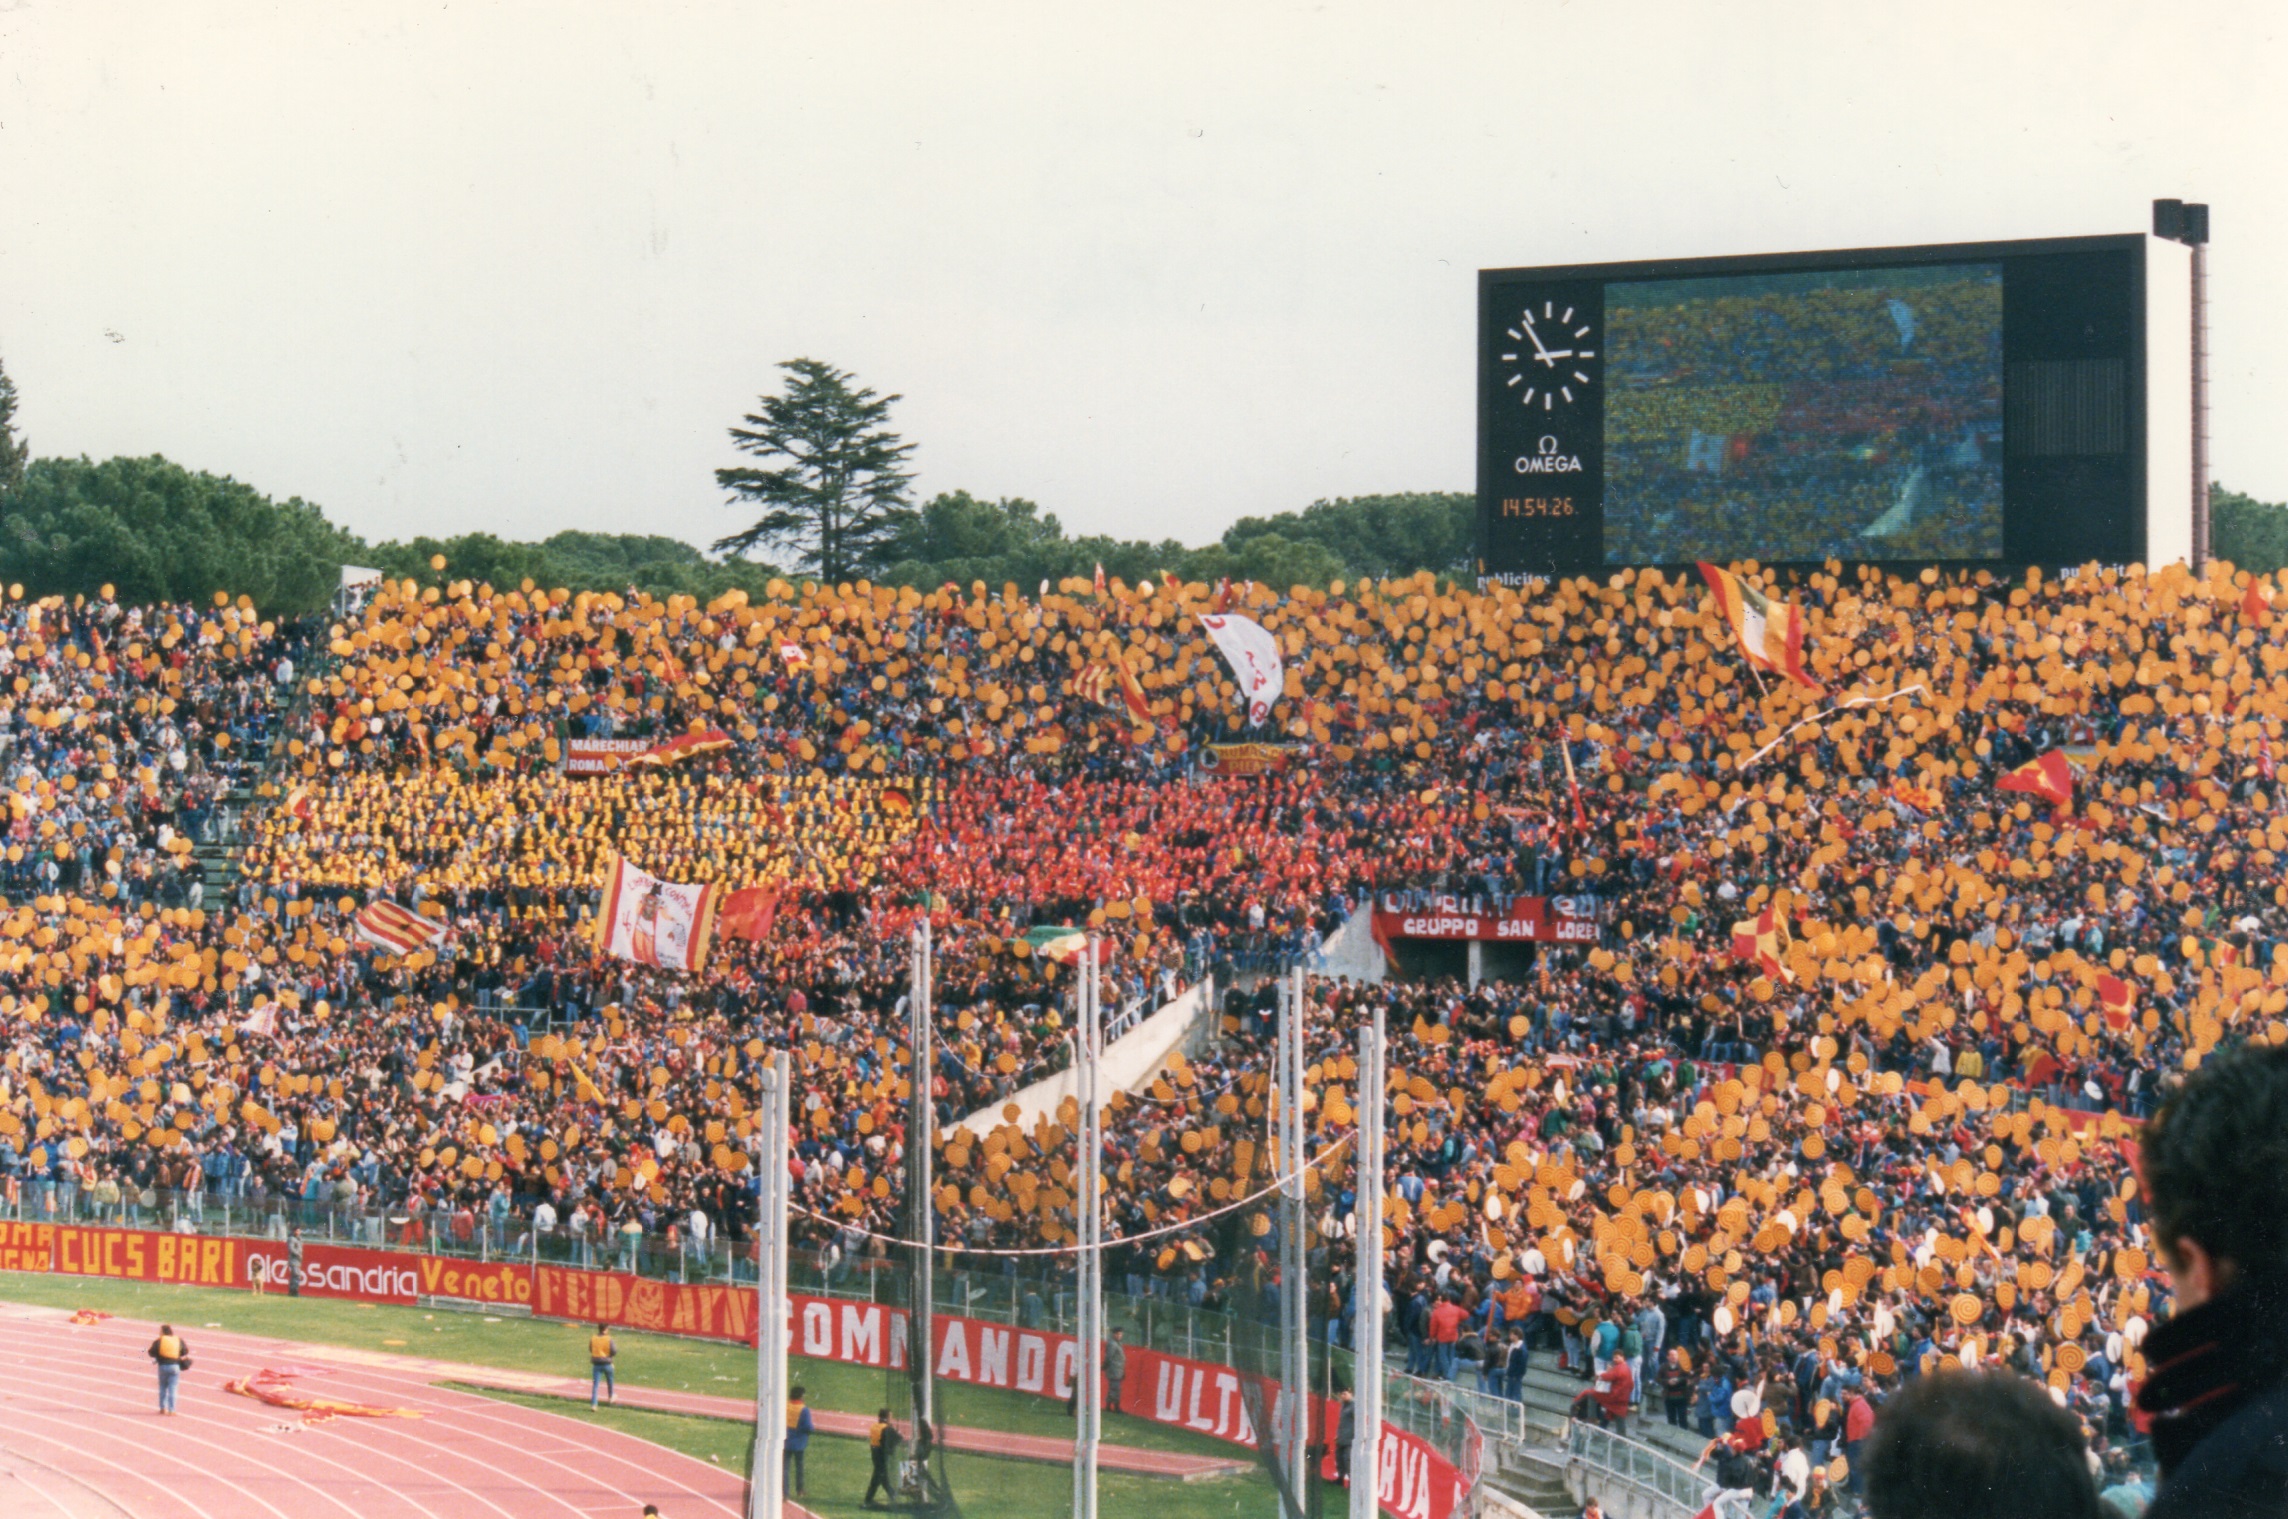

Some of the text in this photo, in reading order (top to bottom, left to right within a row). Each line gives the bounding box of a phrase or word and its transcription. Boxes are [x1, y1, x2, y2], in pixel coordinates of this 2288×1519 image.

[1515, 455, 1582, 473] OMEGA
[569, 759, 605, 771] ROMA
[1403, 918, 1478, 936] GRUPPO
[1497, 919, 1534, 936] SAN
[61, 1230, 234, 1284] CUCS BARI
[421, 1257, 531, 1301] Veneto
[785, 1299, 1083, 1399] OMANDO
